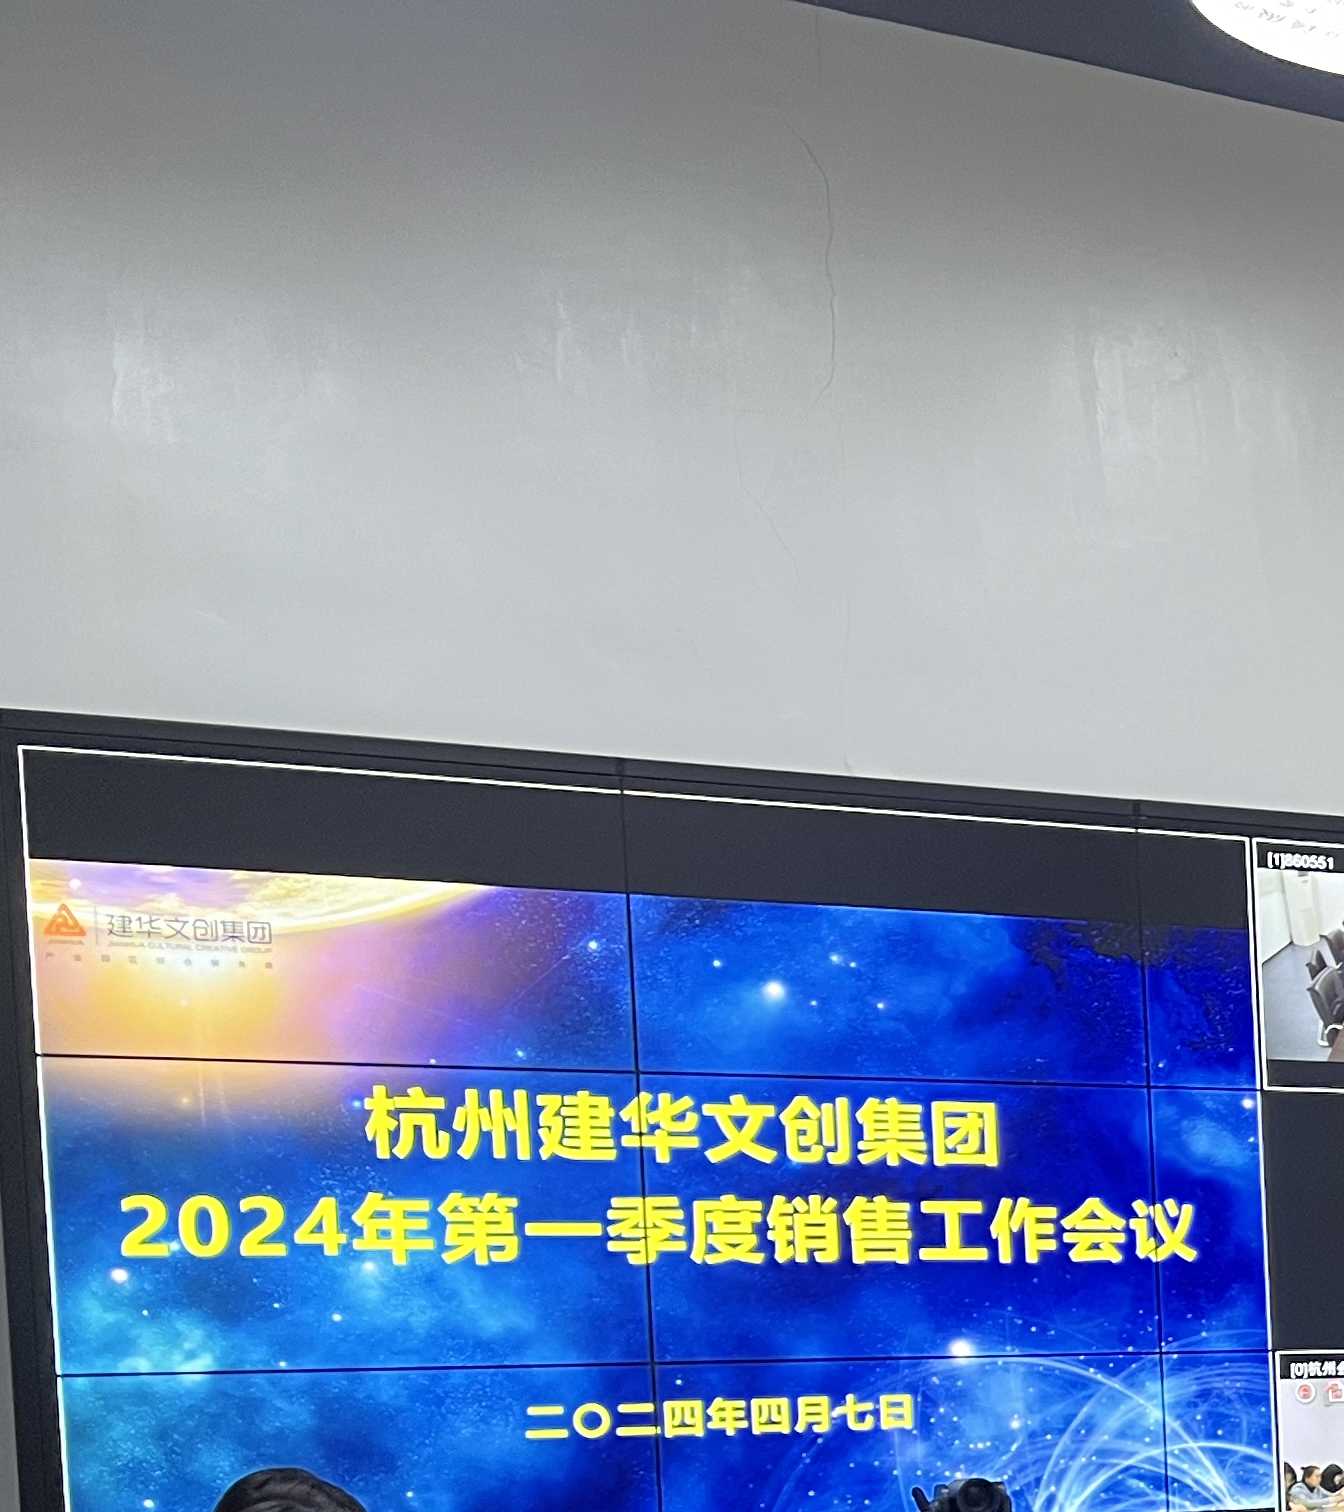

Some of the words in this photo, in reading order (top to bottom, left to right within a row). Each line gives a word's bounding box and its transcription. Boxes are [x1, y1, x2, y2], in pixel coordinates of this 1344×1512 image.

[106, 914, 273, 944] 建华文创集团
[364, 1084, 1000, 1167] 杭州建华文创集团
[120, 1191, 1197, 1265] 2024年第一季度销售工作会议
